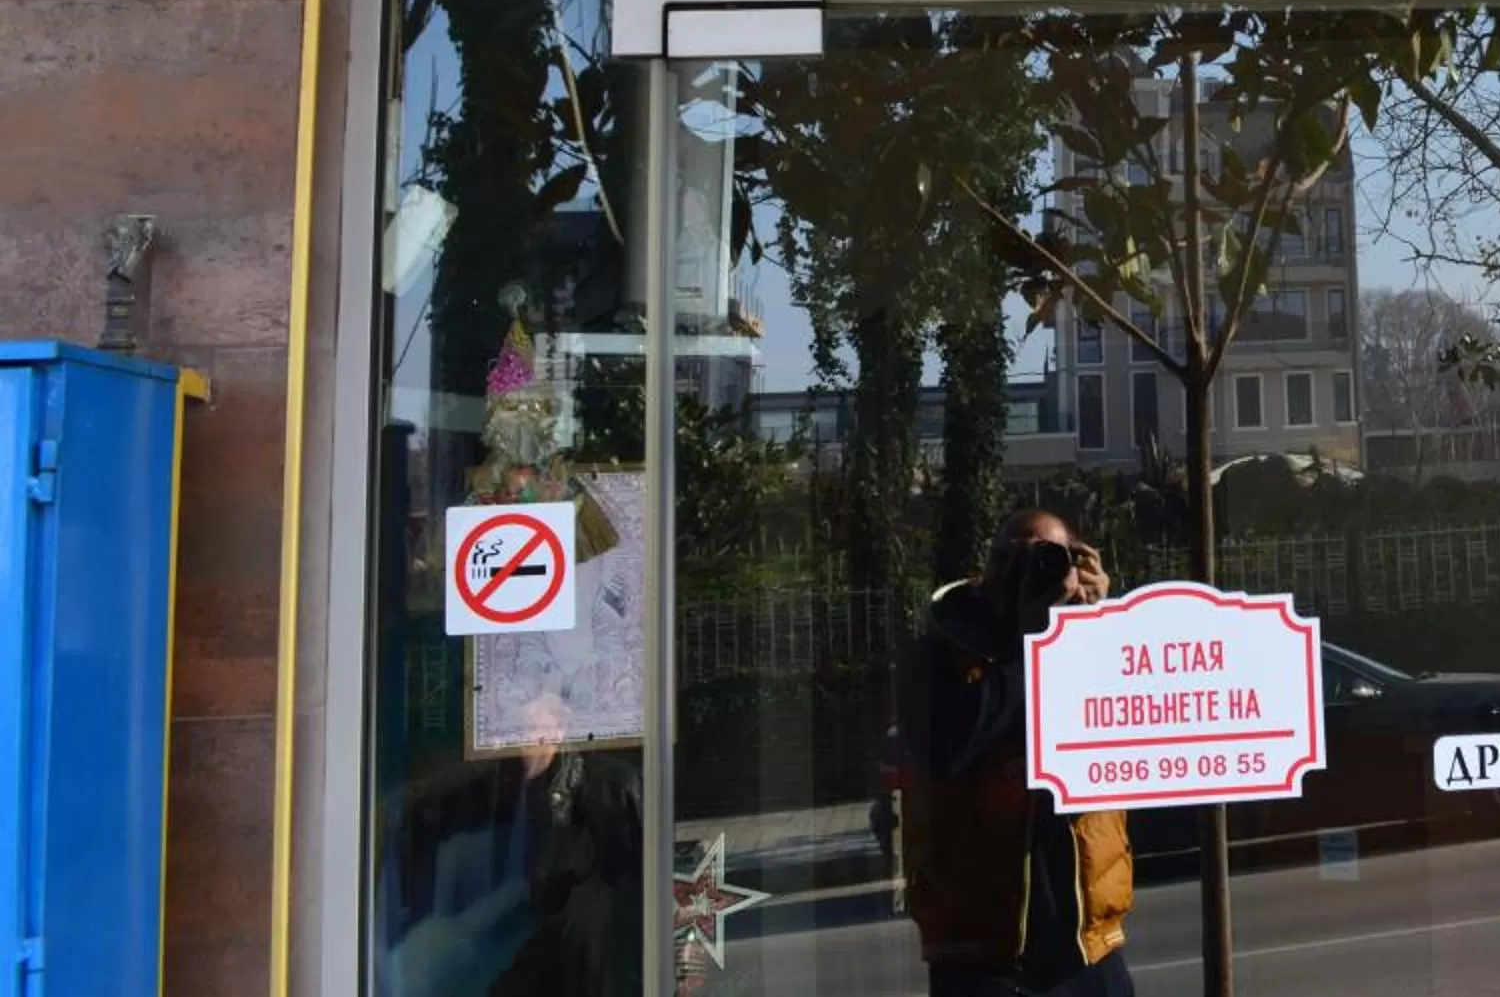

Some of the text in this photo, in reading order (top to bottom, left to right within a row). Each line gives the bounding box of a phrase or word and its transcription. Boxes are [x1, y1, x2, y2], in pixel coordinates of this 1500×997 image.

[1121, 640, 1224, 676] ЗА СТАЯ
[1084, 688, 1261, 728] ПОЗВЪНЕТЕ НА
[1088, 753, 1266, 784] 0896 99 08 55
